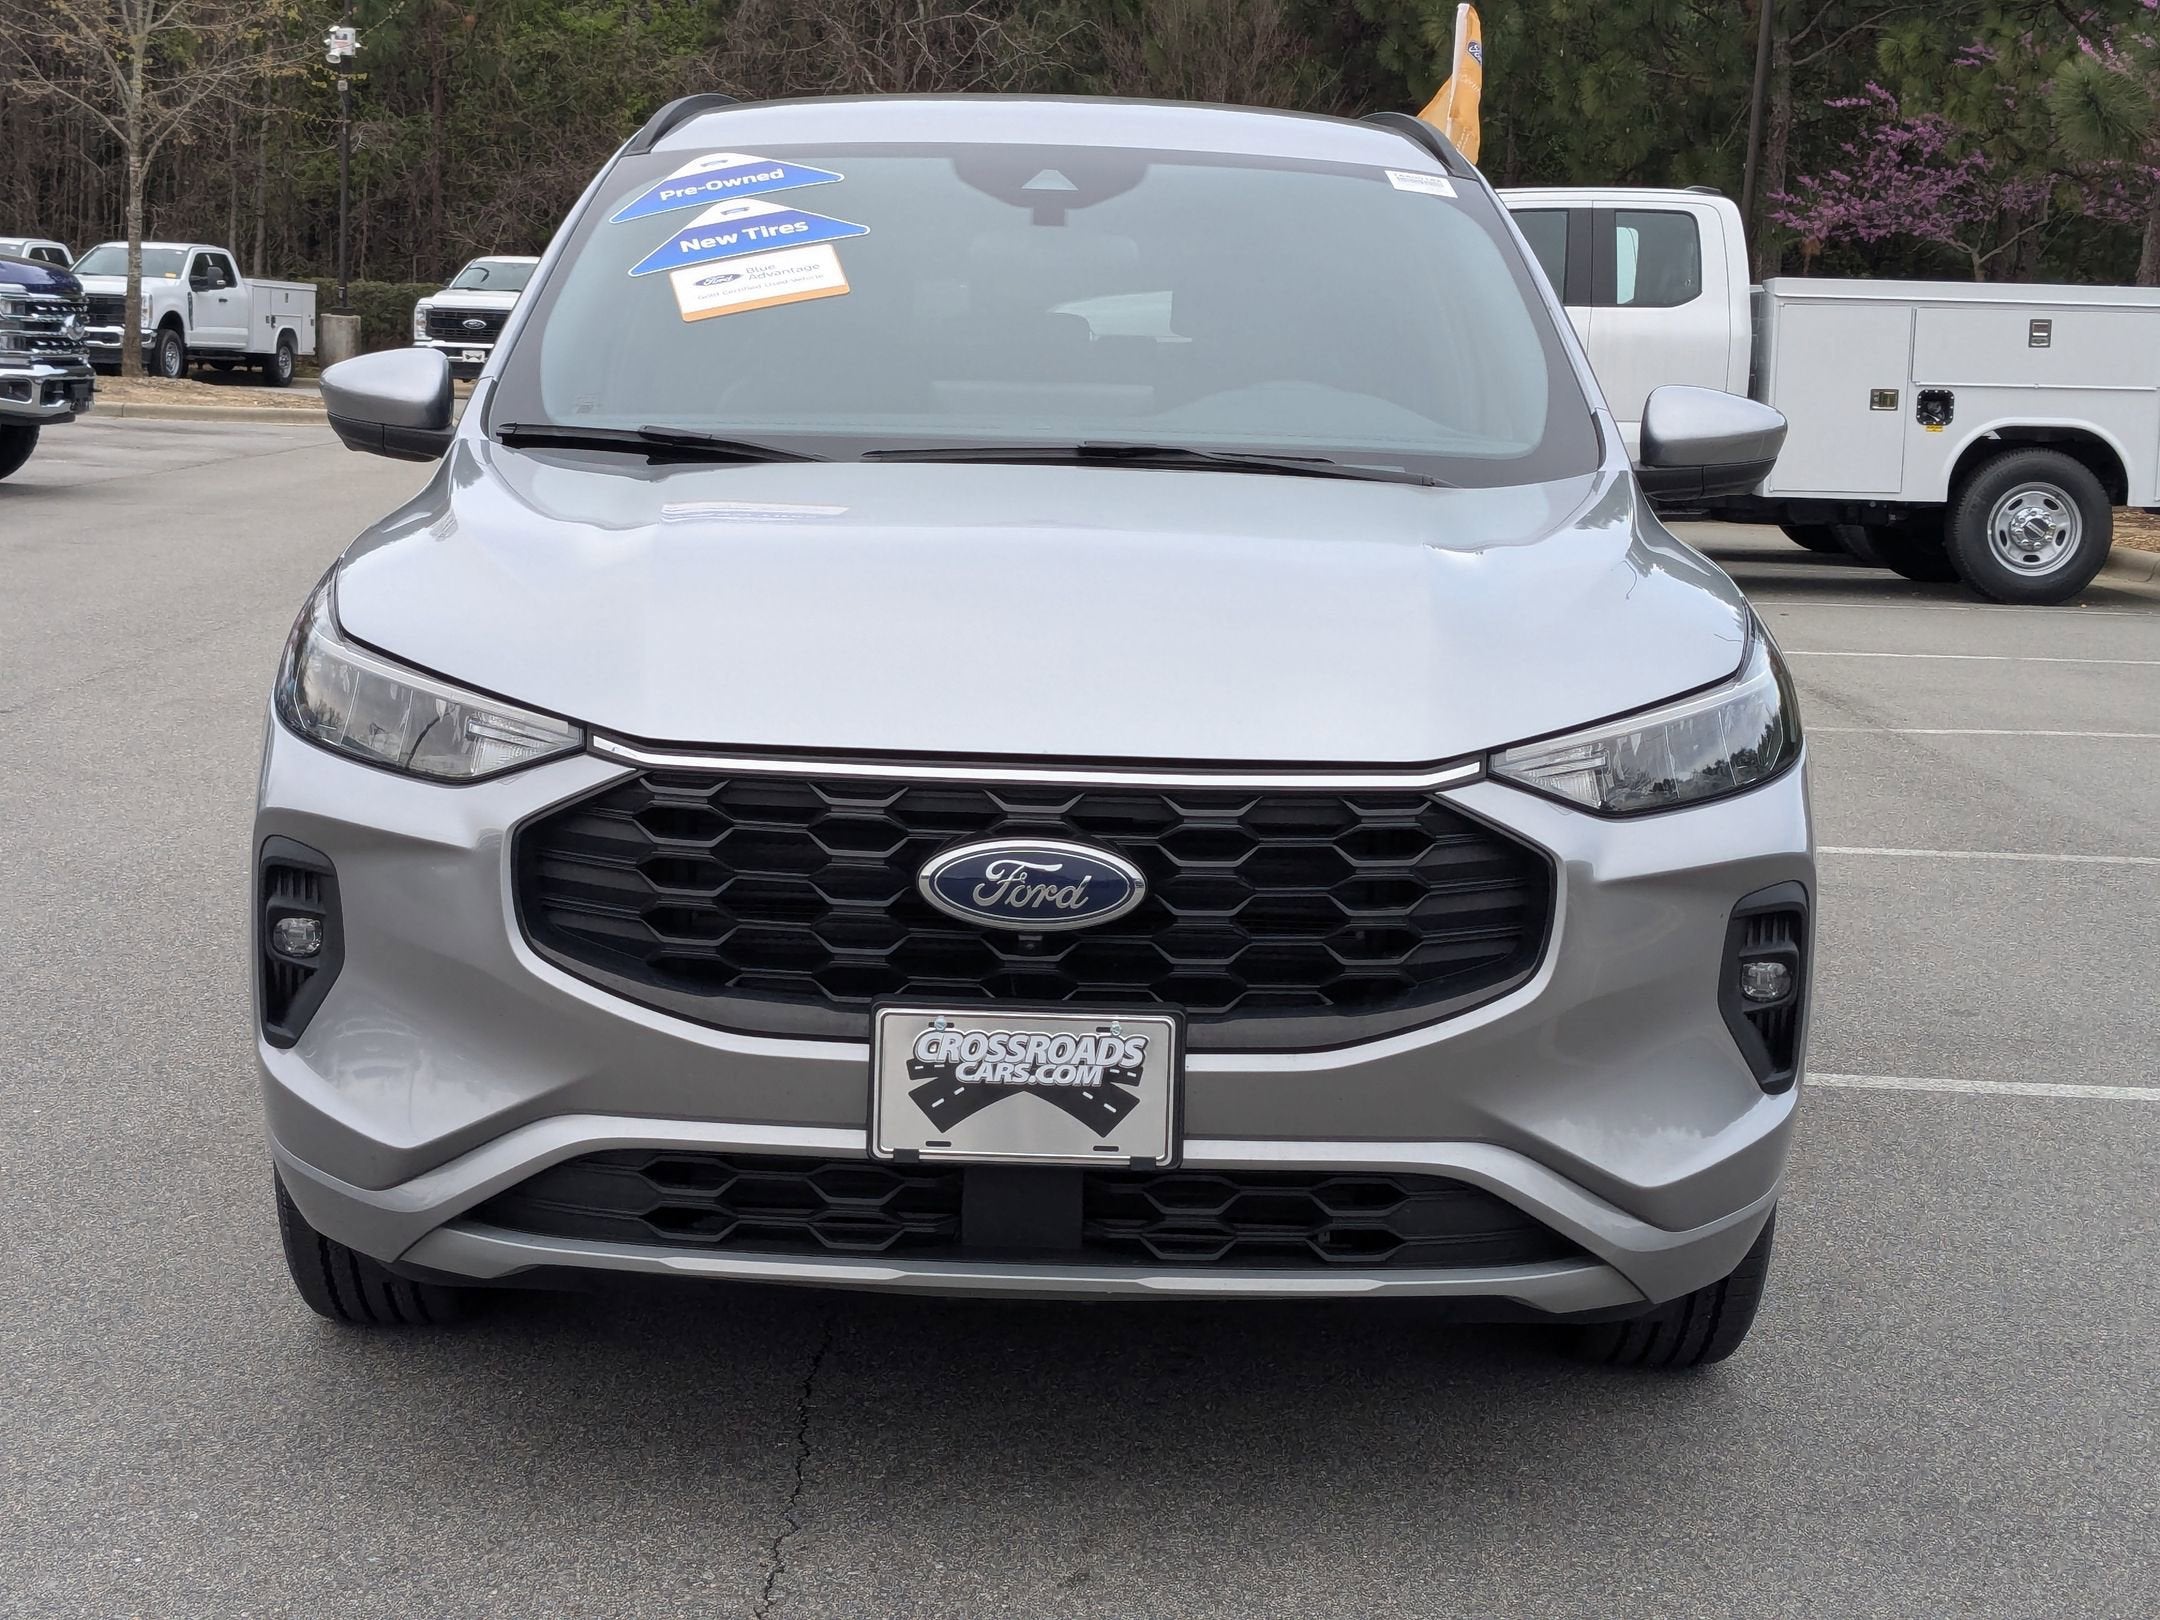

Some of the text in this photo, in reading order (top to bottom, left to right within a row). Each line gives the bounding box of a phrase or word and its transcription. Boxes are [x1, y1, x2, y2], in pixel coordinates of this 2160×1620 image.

[659, 168, 785, 201] Pre-Owned
[679, 221, 810, 253] New Tires
[746, 264, 776, 275] Blue
[748, 263, 821, 281] Advantage
[972, 859, 1093, 910] Ford
[914, 1030, 1149, 1068] CROSSROADS
[955, 1061, 1105, 1087] CARS.COM
